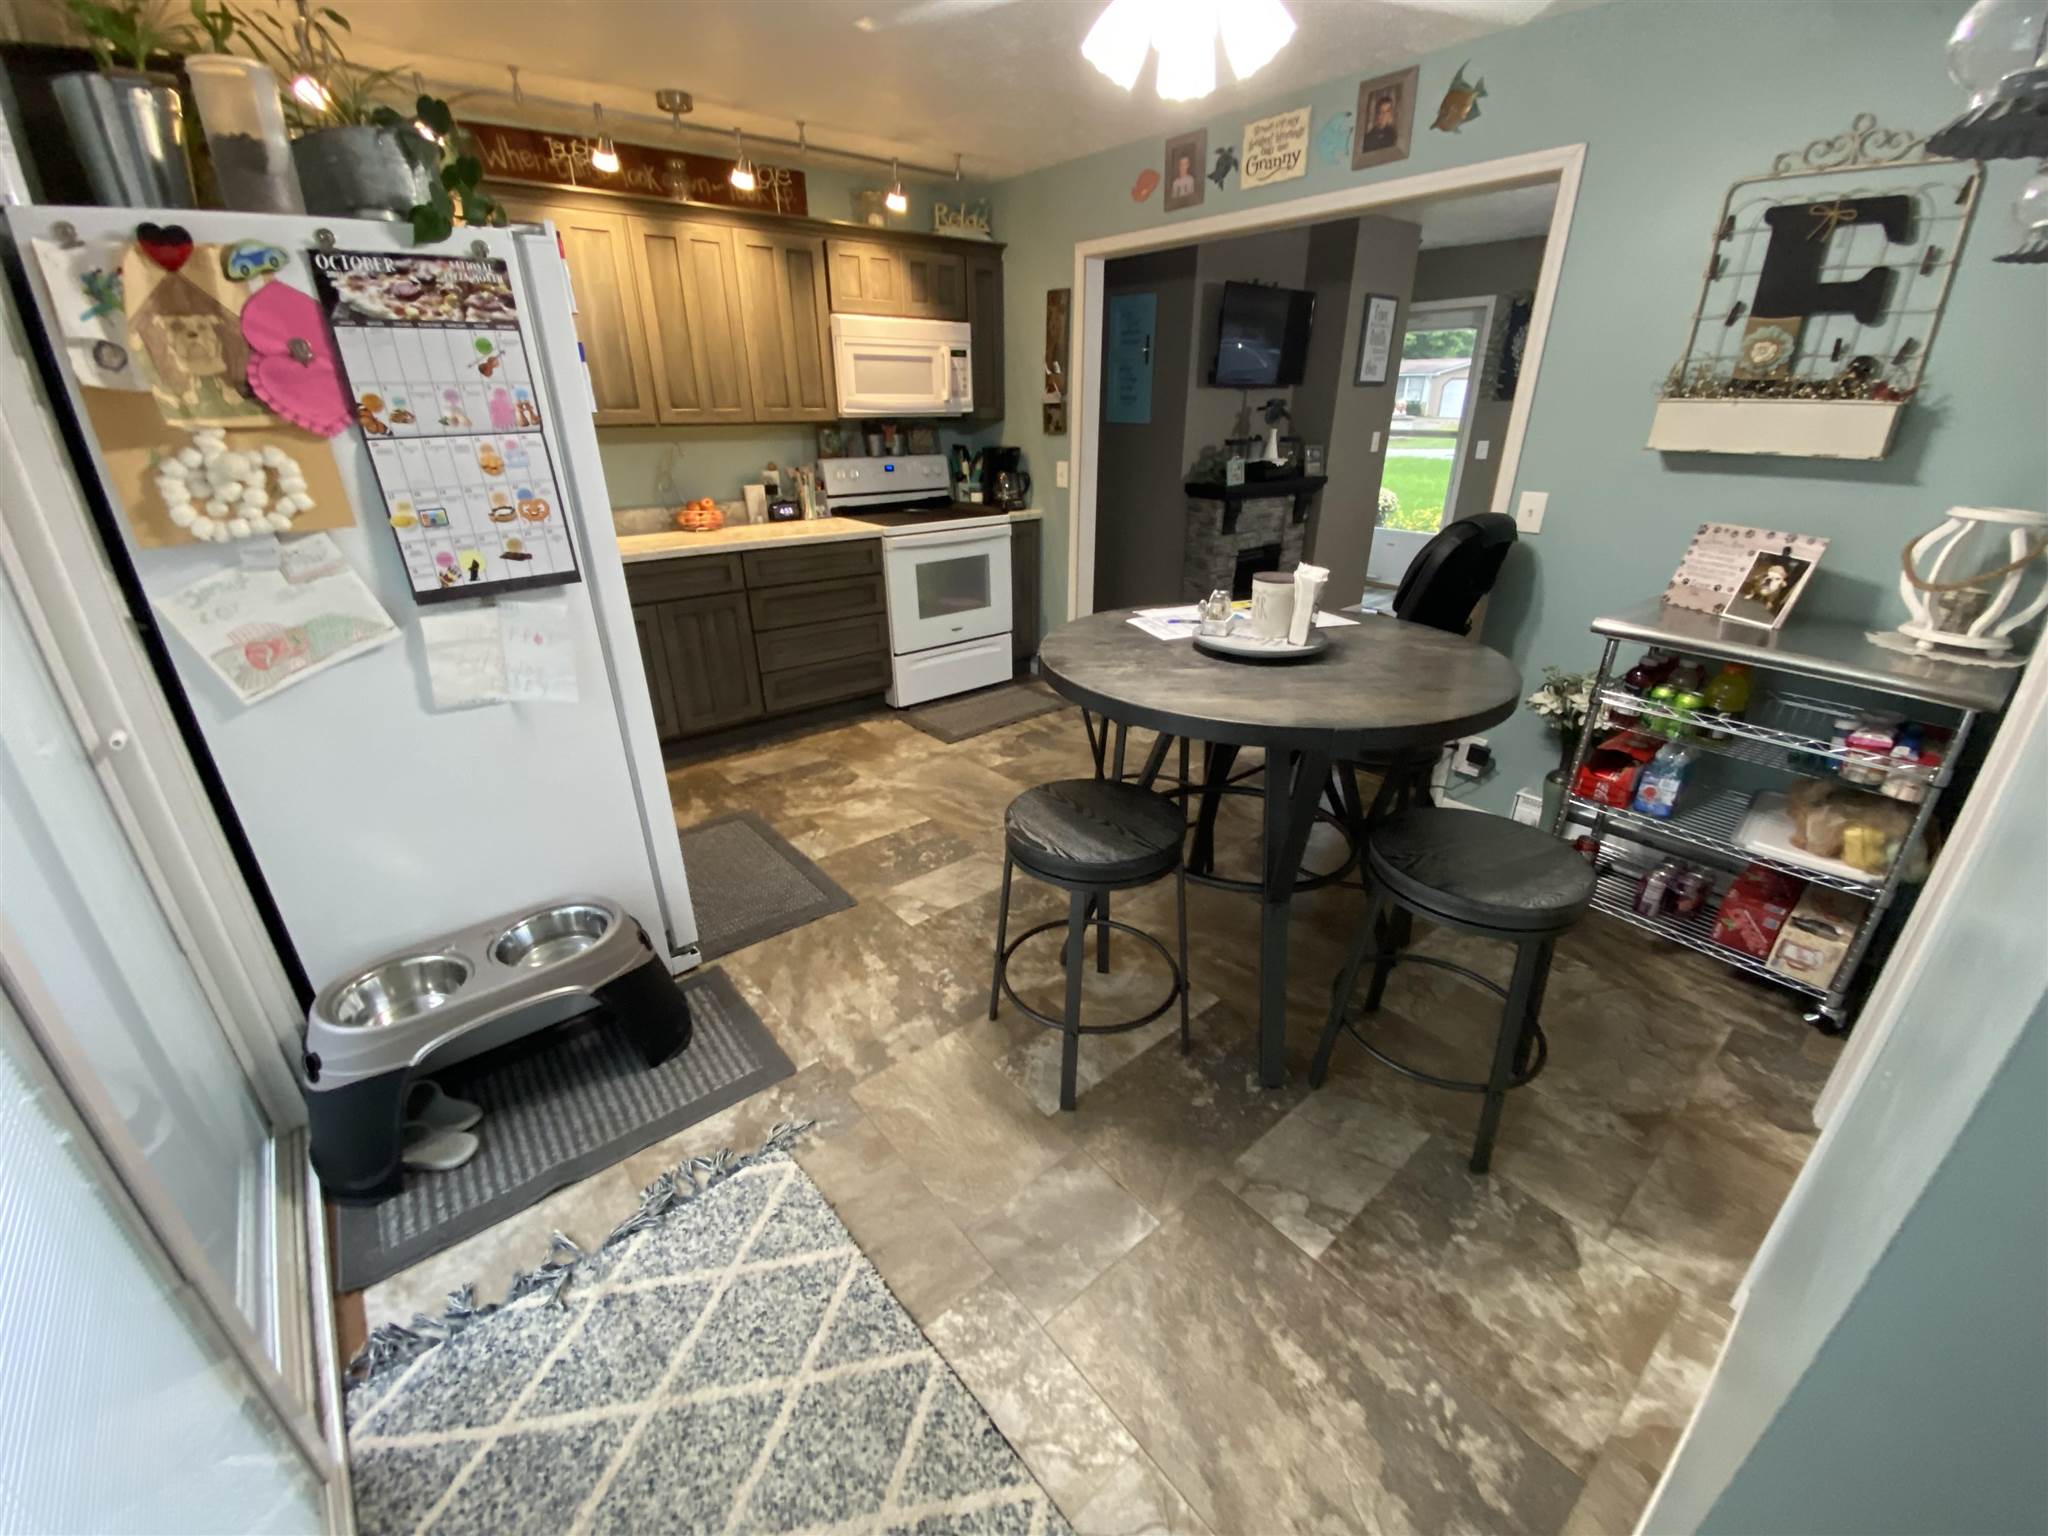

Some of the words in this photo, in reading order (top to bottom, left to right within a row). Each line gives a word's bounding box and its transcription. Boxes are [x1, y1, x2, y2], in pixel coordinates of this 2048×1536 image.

[475, 132, 549, 173] When
[1246, 149, 1301, 181] Granny
[314, 253, 398, 273] OCTOBER
